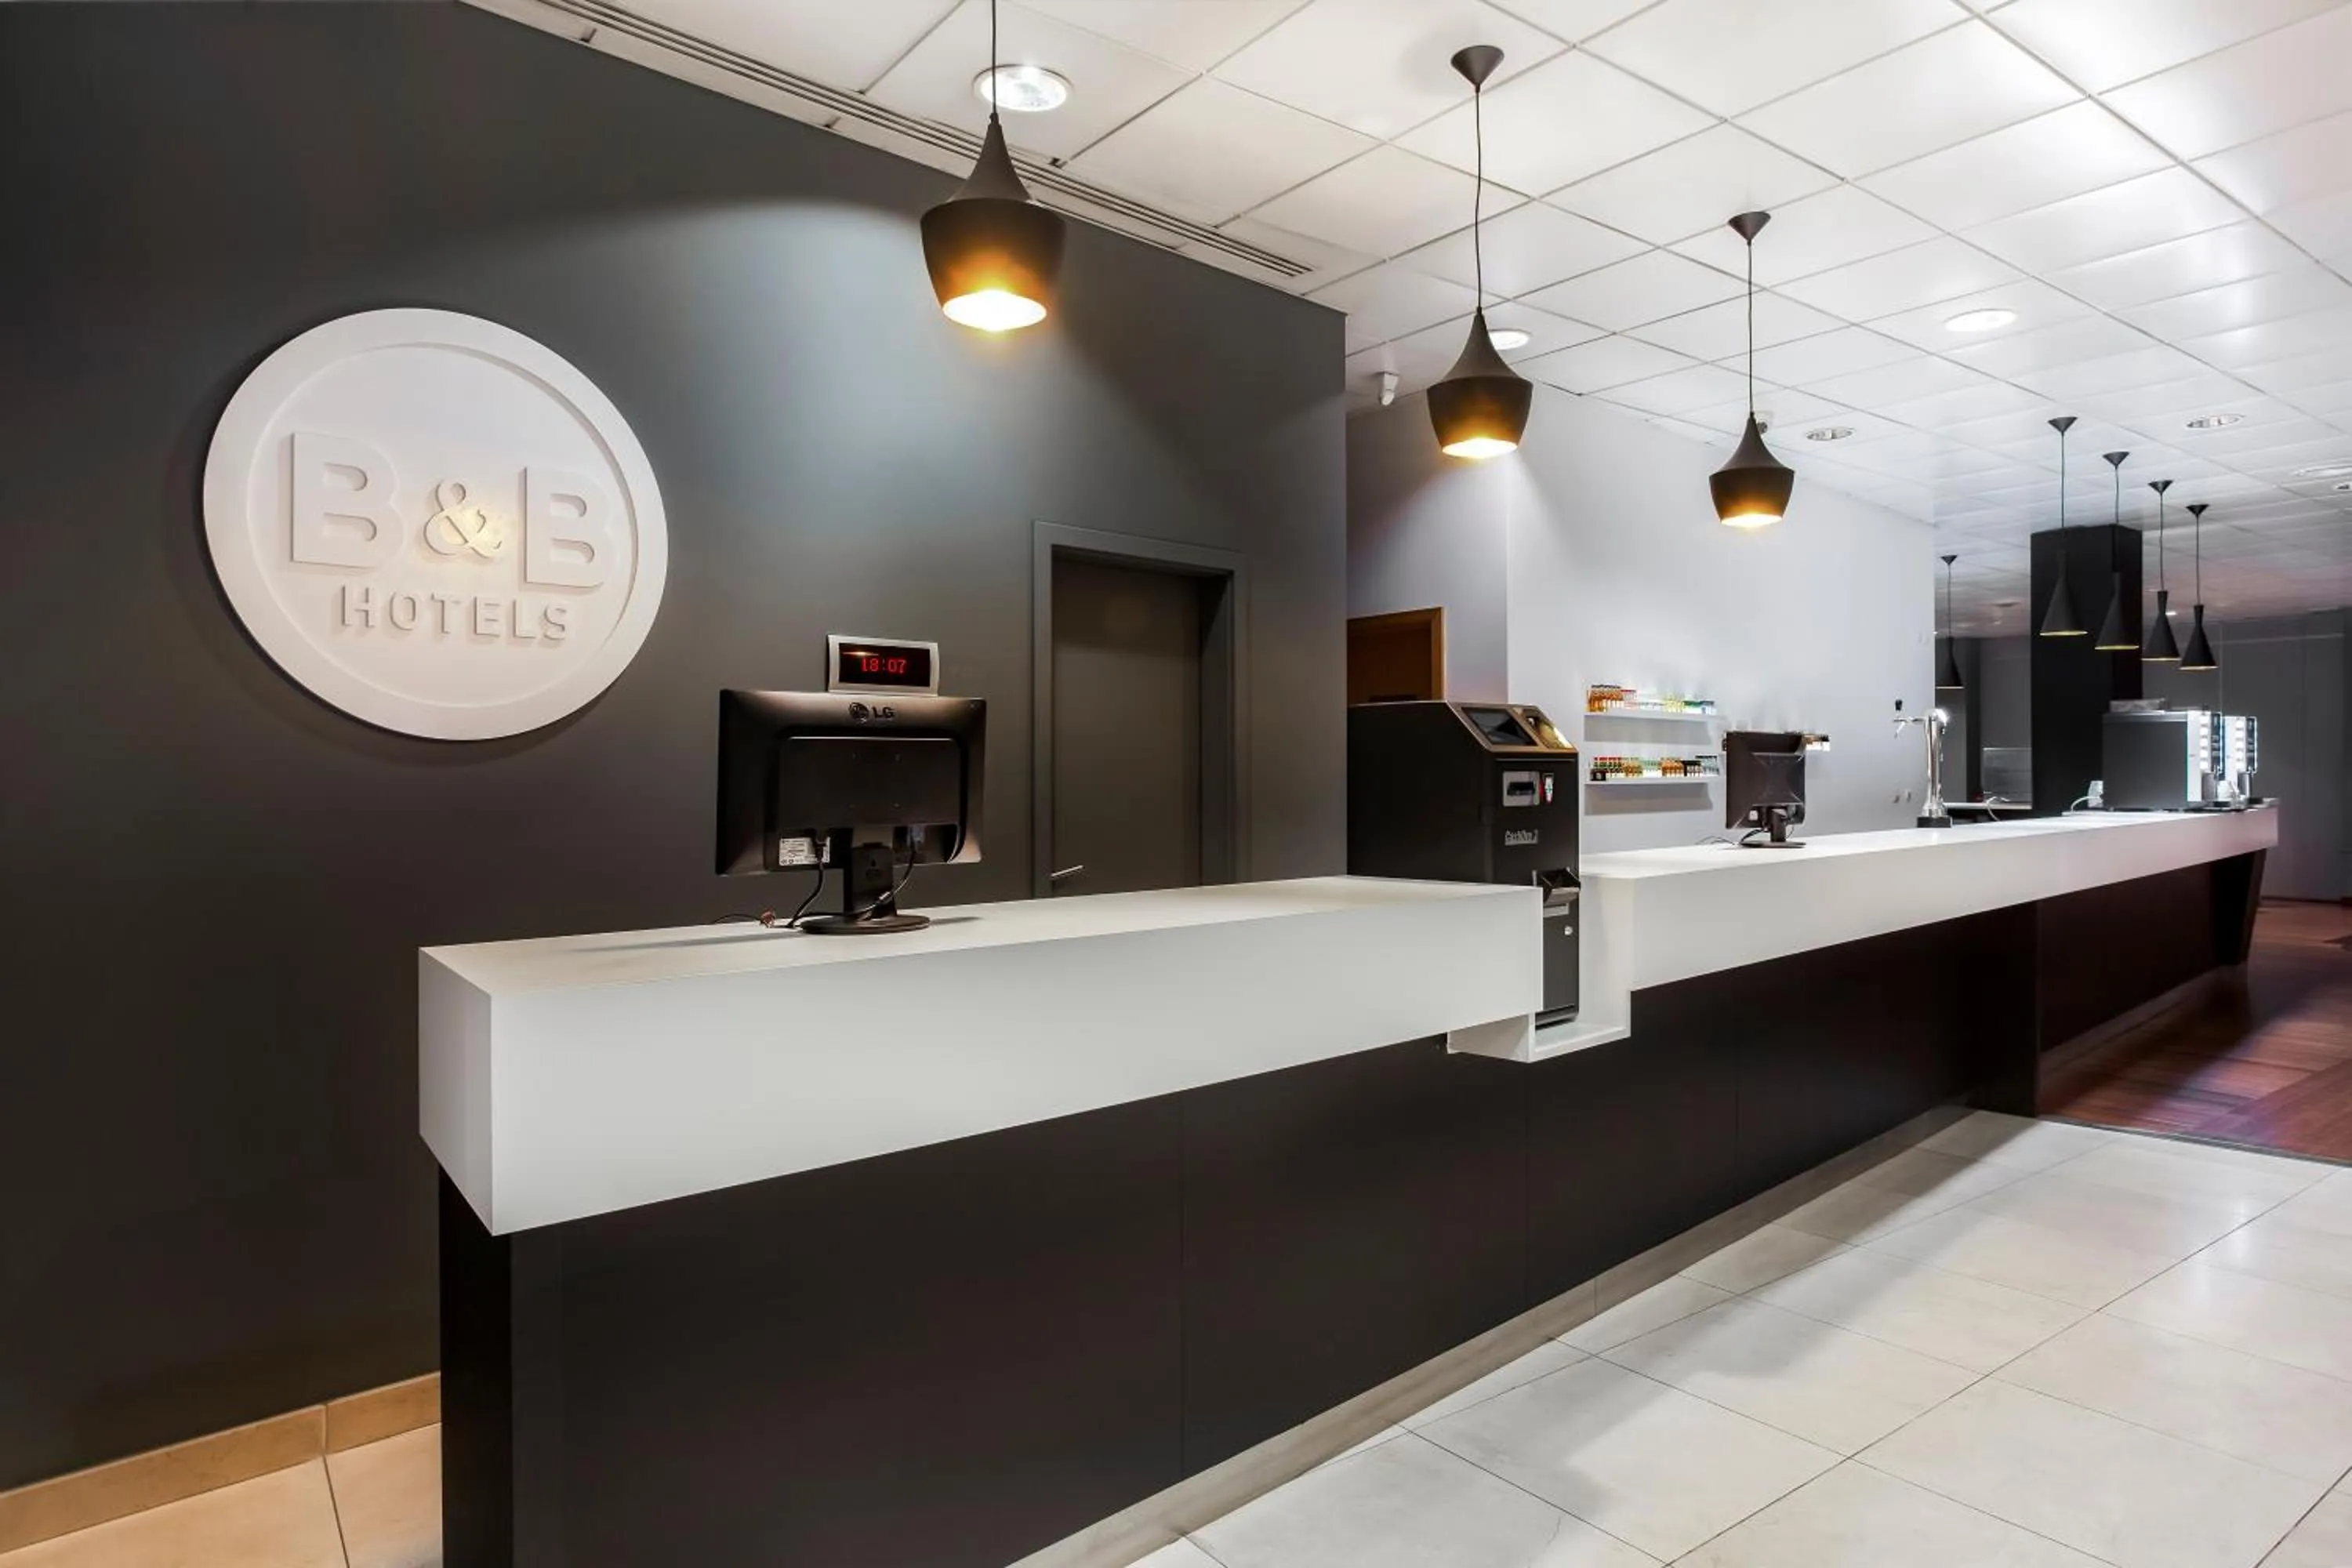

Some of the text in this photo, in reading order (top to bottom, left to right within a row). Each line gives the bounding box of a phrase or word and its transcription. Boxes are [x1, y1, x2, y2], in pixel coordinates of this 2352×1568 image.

[340, 584, 569, 641] HOTELS
[862, 658, 906, 673] 18:07
[872, 706, 895, 718] LG
